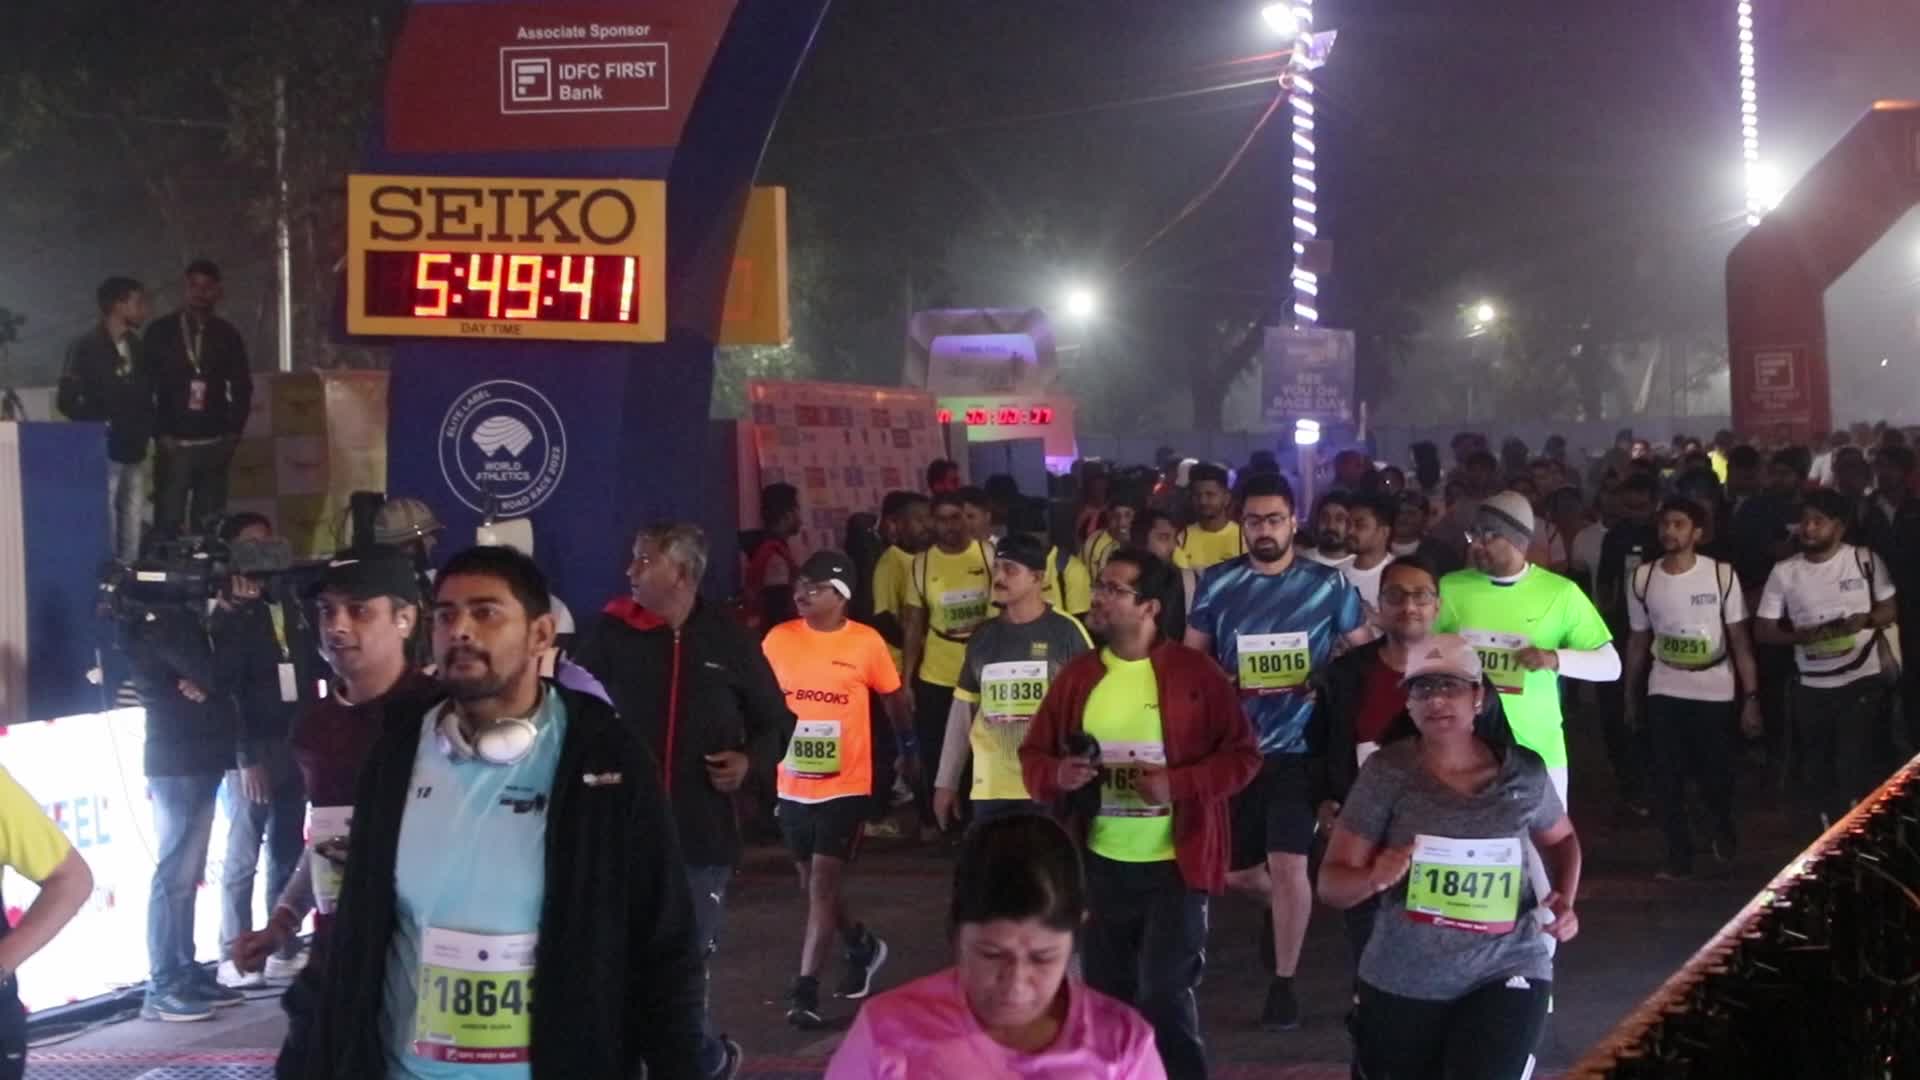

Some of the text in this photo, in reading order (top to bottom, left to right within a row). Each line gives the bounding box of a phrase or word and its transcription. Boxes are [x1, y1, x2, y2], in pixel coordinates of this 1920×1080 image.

[517, 24, 651, 41] Associate Sponsor
[558, 62, 656, 80] IDFC FIRST
[559, 85, 602, 101] Bank
[369, 185, 637, 246] SEIKO
[414, 253, 636, 321] 5:49:41
[460, 322, 521, 336] DAY TIME
[446, 389, 491, 438] ELITE LABEL
[485, 461, 522, 471] WORLD
[476, 471, 530, 481] ATHLETICS
[501, 446, 561, 510] ROAD RACE 2022
[1248, 652, 1305, 673] 18016
[796, 689, 849, 705] BROOKS
[989, 682, 1043, 701] 18838
[1425, 869, 1512, 898] 18471
